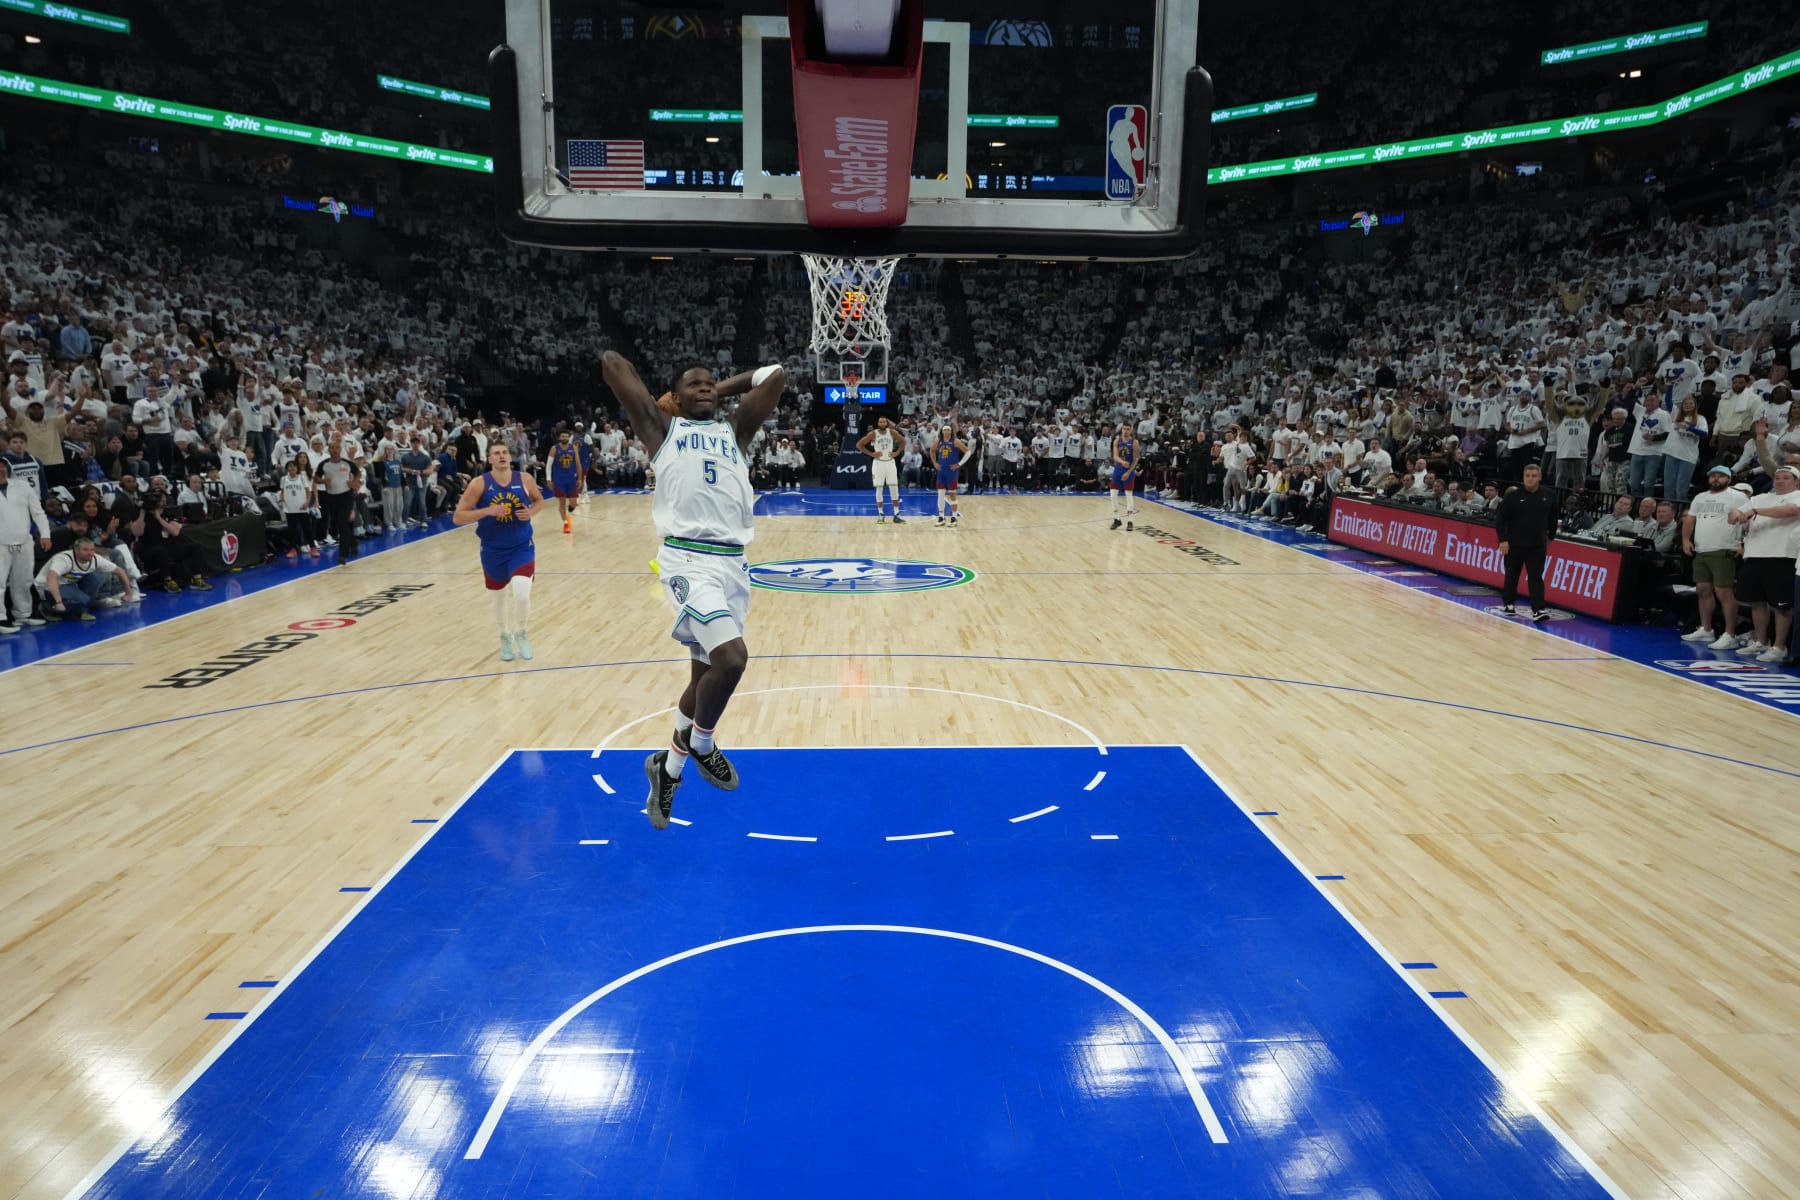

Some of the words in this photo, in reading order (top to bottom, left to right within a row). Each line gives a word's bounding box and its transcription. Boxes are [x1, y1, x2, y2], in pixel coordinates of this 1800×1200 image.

[43, 4, 78, 20] Sprite
[1624, 34, 1656, 50] Sprite
[1545, 49, 1574, 64] Sprite
[0, 76, 35, 92] prite
[1741, 65, 1774, 89] Sprite
[113, 95, 155, 113] Sprite
[1664, 96, 1692, 118] Sprite
[223, 114, 260, 131] Sprite
[652, 111, 673, 120] Sprite
[708, 112, 729, 121] Sprite
[1006, 117, 1027, 126] Sprite
[1560, 117, 1600, 136] Sprite
[320, 131, 353, 147] Sprite
[1461, 132, 1497, 149] Sprite
[406, 146, 437, 161] Sprite
[1372, 145, 1405, 160] Sprite
[1292, 156, 1321, 172] Sprite
[1219, 167, 1246, 181] Sprite
[1112, 179, 1130, 194] NBA
[676, 433, 738, 465] WOLVES
[703, 459, 718, 486] 5
[27, 477, 36, 488] 5
[1333, 509, 1384, 542] Emirates
[1386, 520, 1403, 547] FLY
[1403, 524, 1438, 555] BETTER
[1444, 533, 1504, 575] Emirat
[1550, 555, 1608, 600] BETTER
[327, 583, 435, 617] TARGET
[142, 632, 319, 689] CENTER
